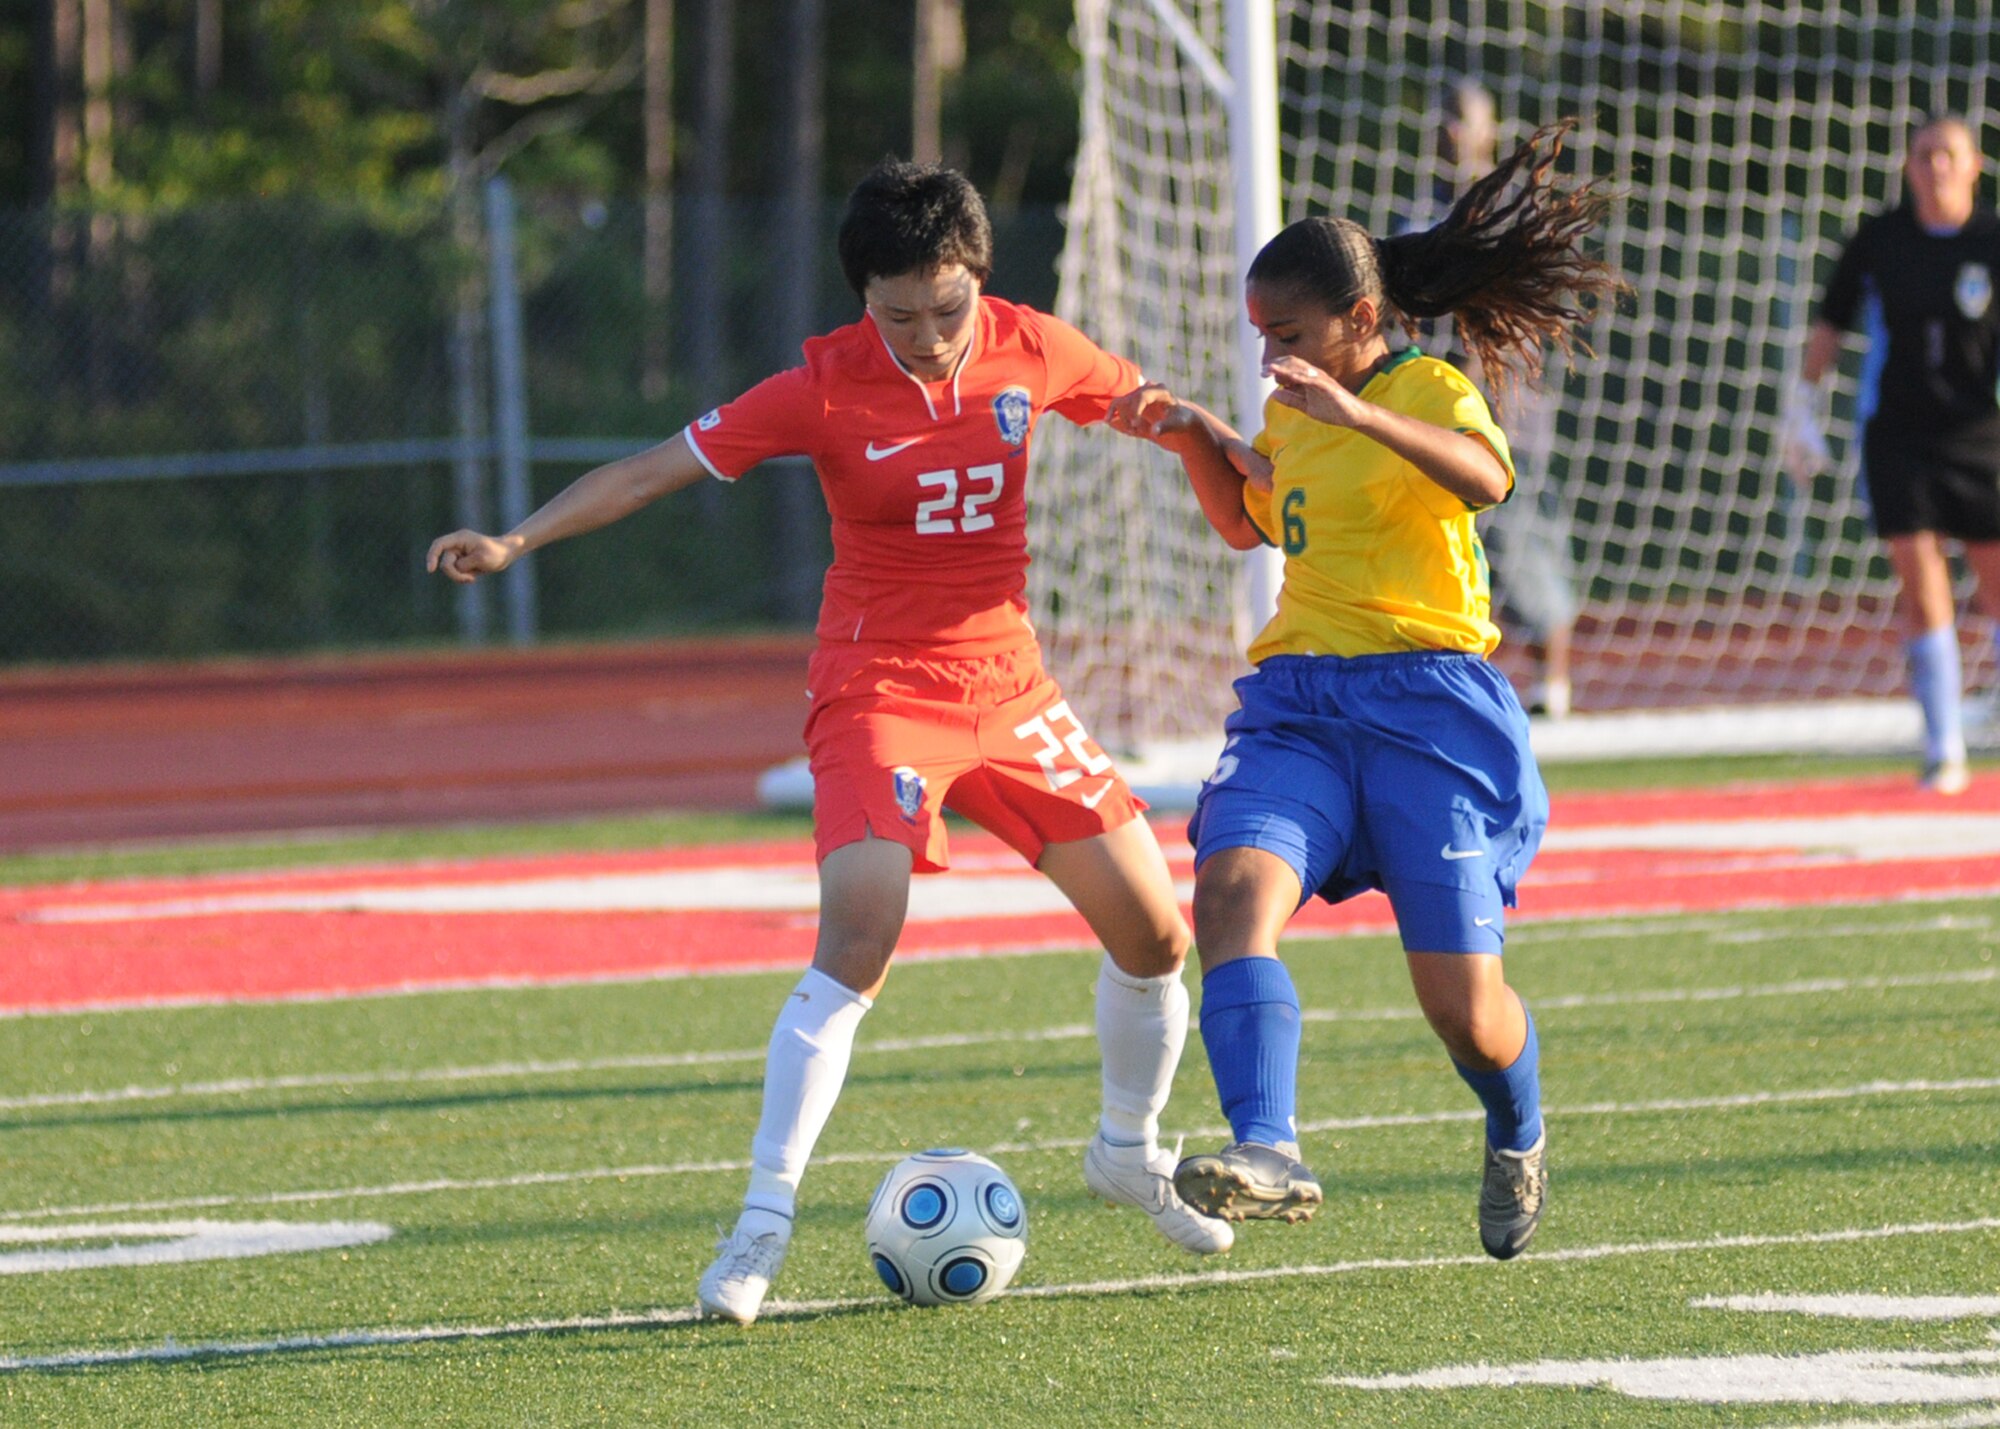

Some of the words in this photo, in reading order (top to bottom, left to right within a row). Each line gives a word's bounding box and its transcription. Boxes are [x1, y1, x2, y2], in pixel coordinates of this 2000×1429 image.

[916, 463, 1004, 534] 22
[1282, 487, 1307, 556] 6
[1013, 700, 1113, 791] 22
